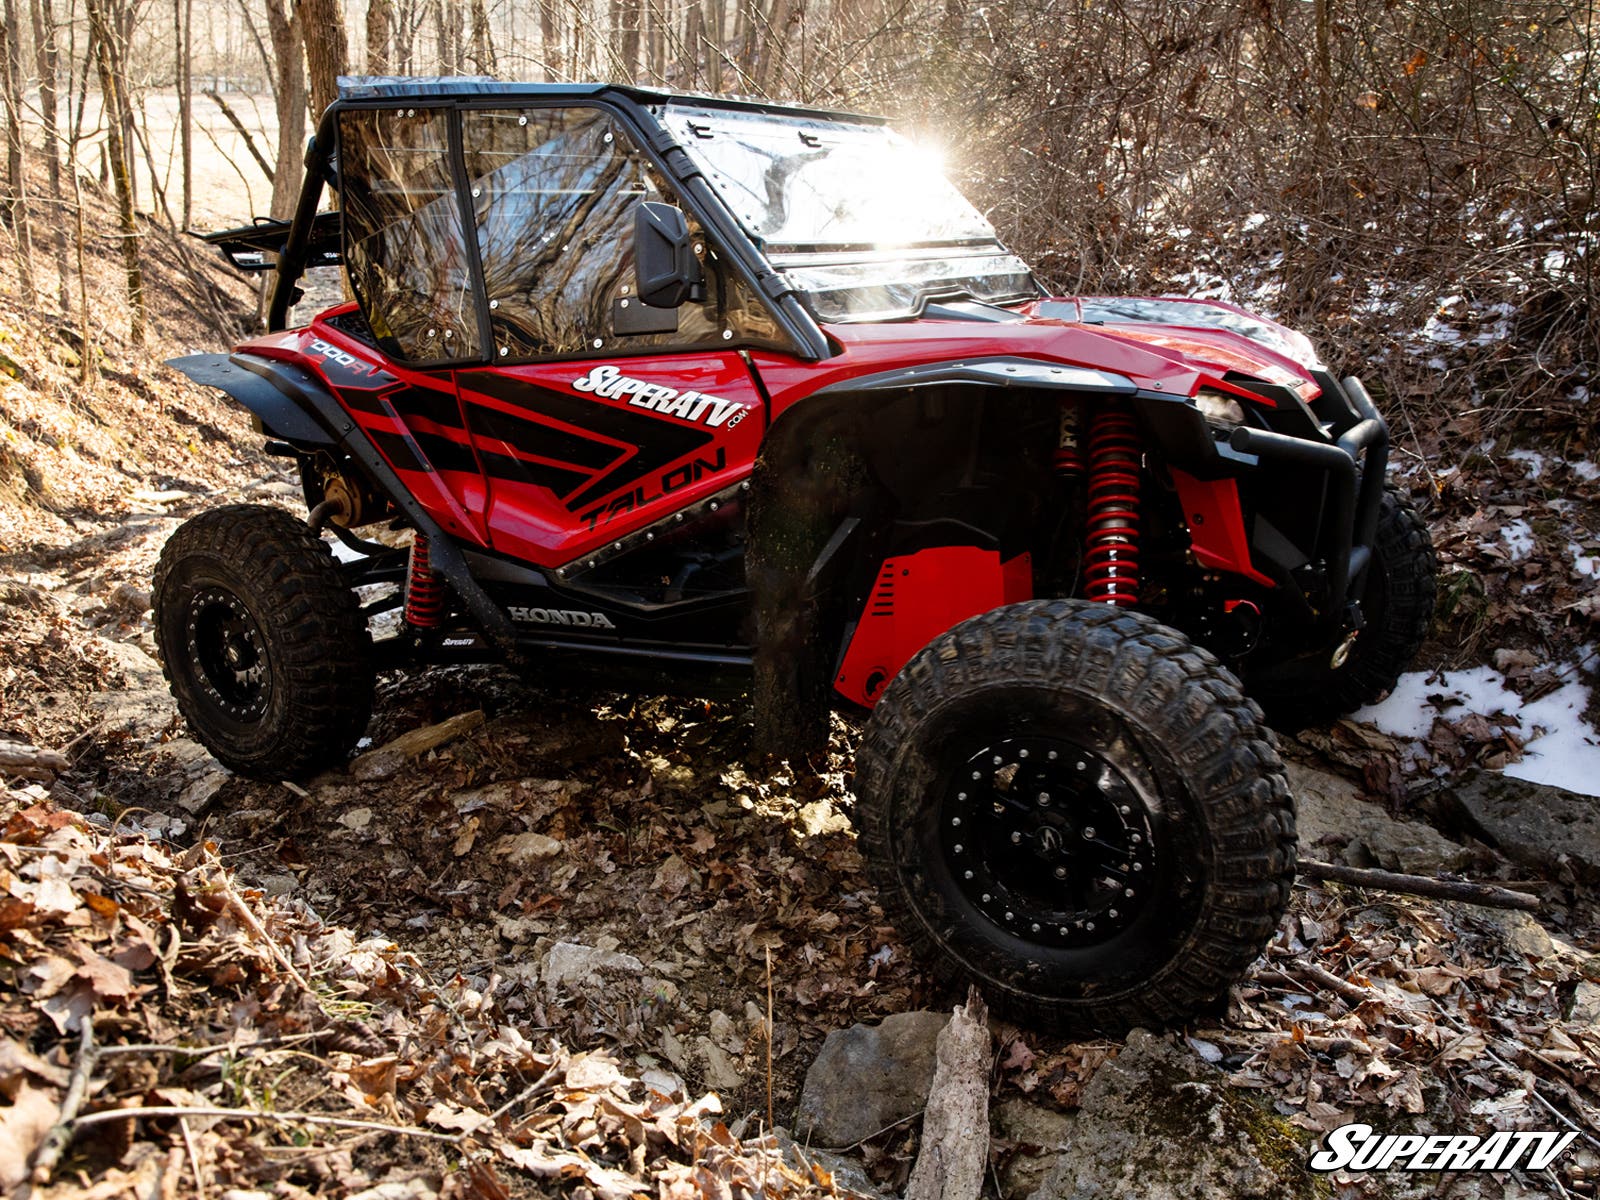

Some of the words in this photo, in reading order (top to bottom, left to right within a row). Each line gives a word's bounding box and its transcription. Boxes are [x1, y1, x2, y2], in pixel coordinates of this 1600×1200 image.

[572, 365, 744, 428] SUPERATV
[580, 446, 727, 532] TALON
[507, 606, 616, 629] HONDA
